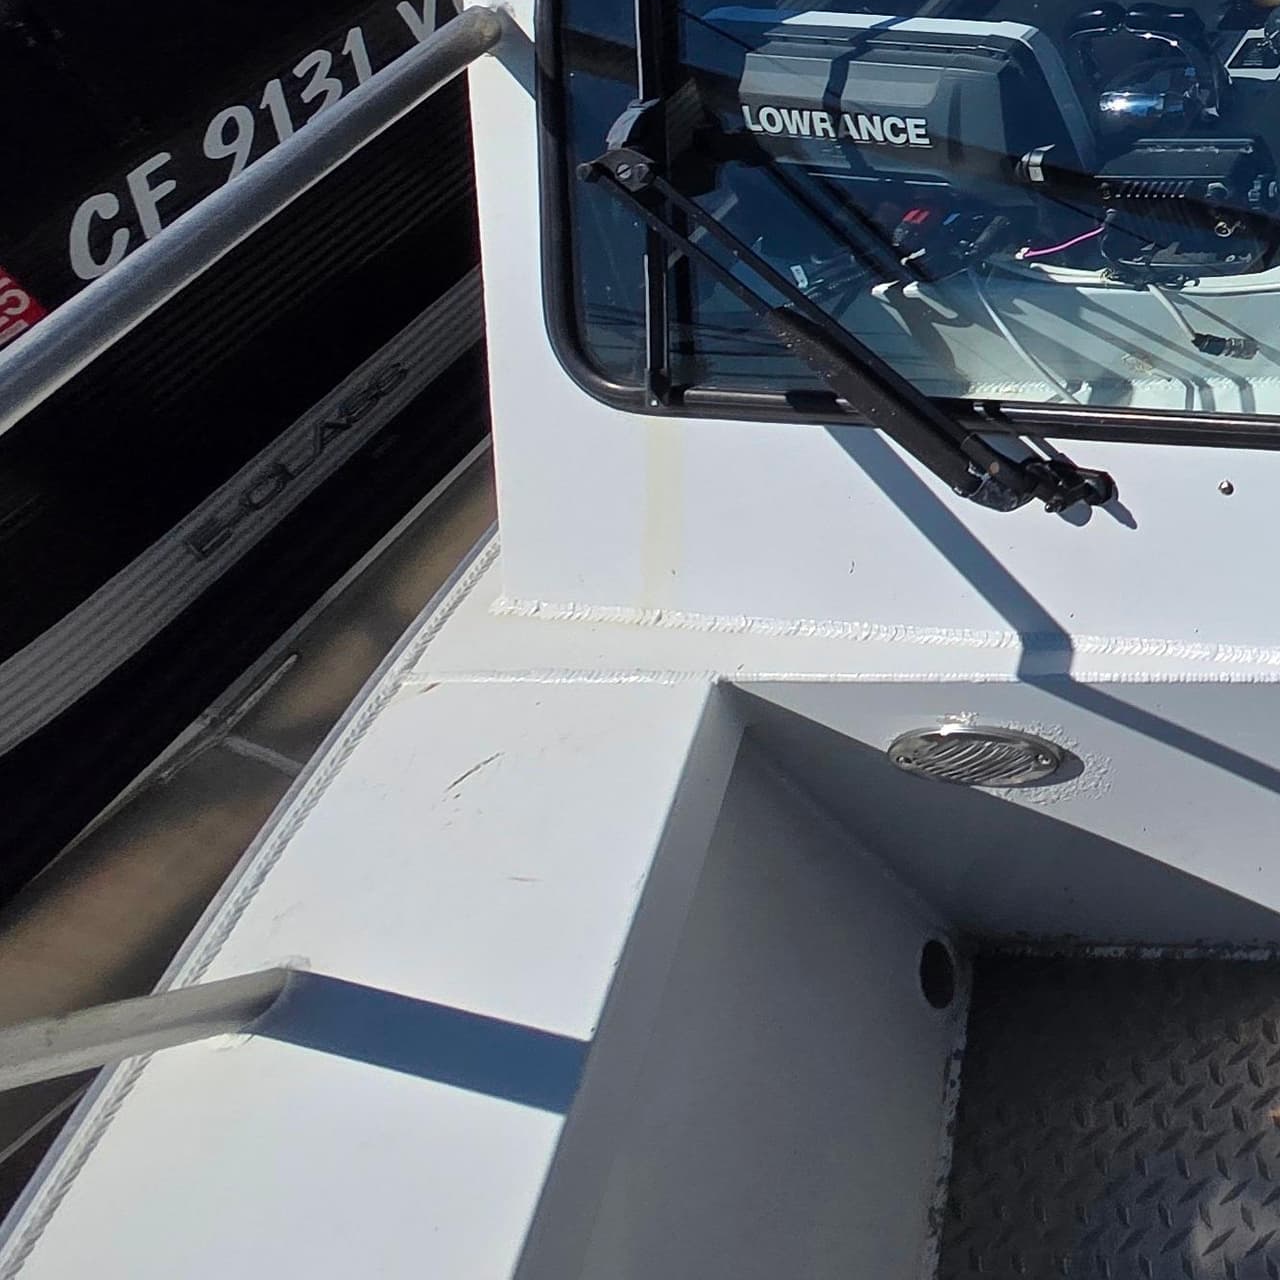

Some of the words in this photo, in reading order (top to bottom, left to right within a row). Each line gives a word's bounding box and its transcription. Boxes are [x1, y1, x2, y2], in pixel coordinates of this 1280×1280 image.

[69, 152, 176, 280] CF
[203, 27, 372, 182] 9131
[741, 105, 932, 148] LOWRANCE
